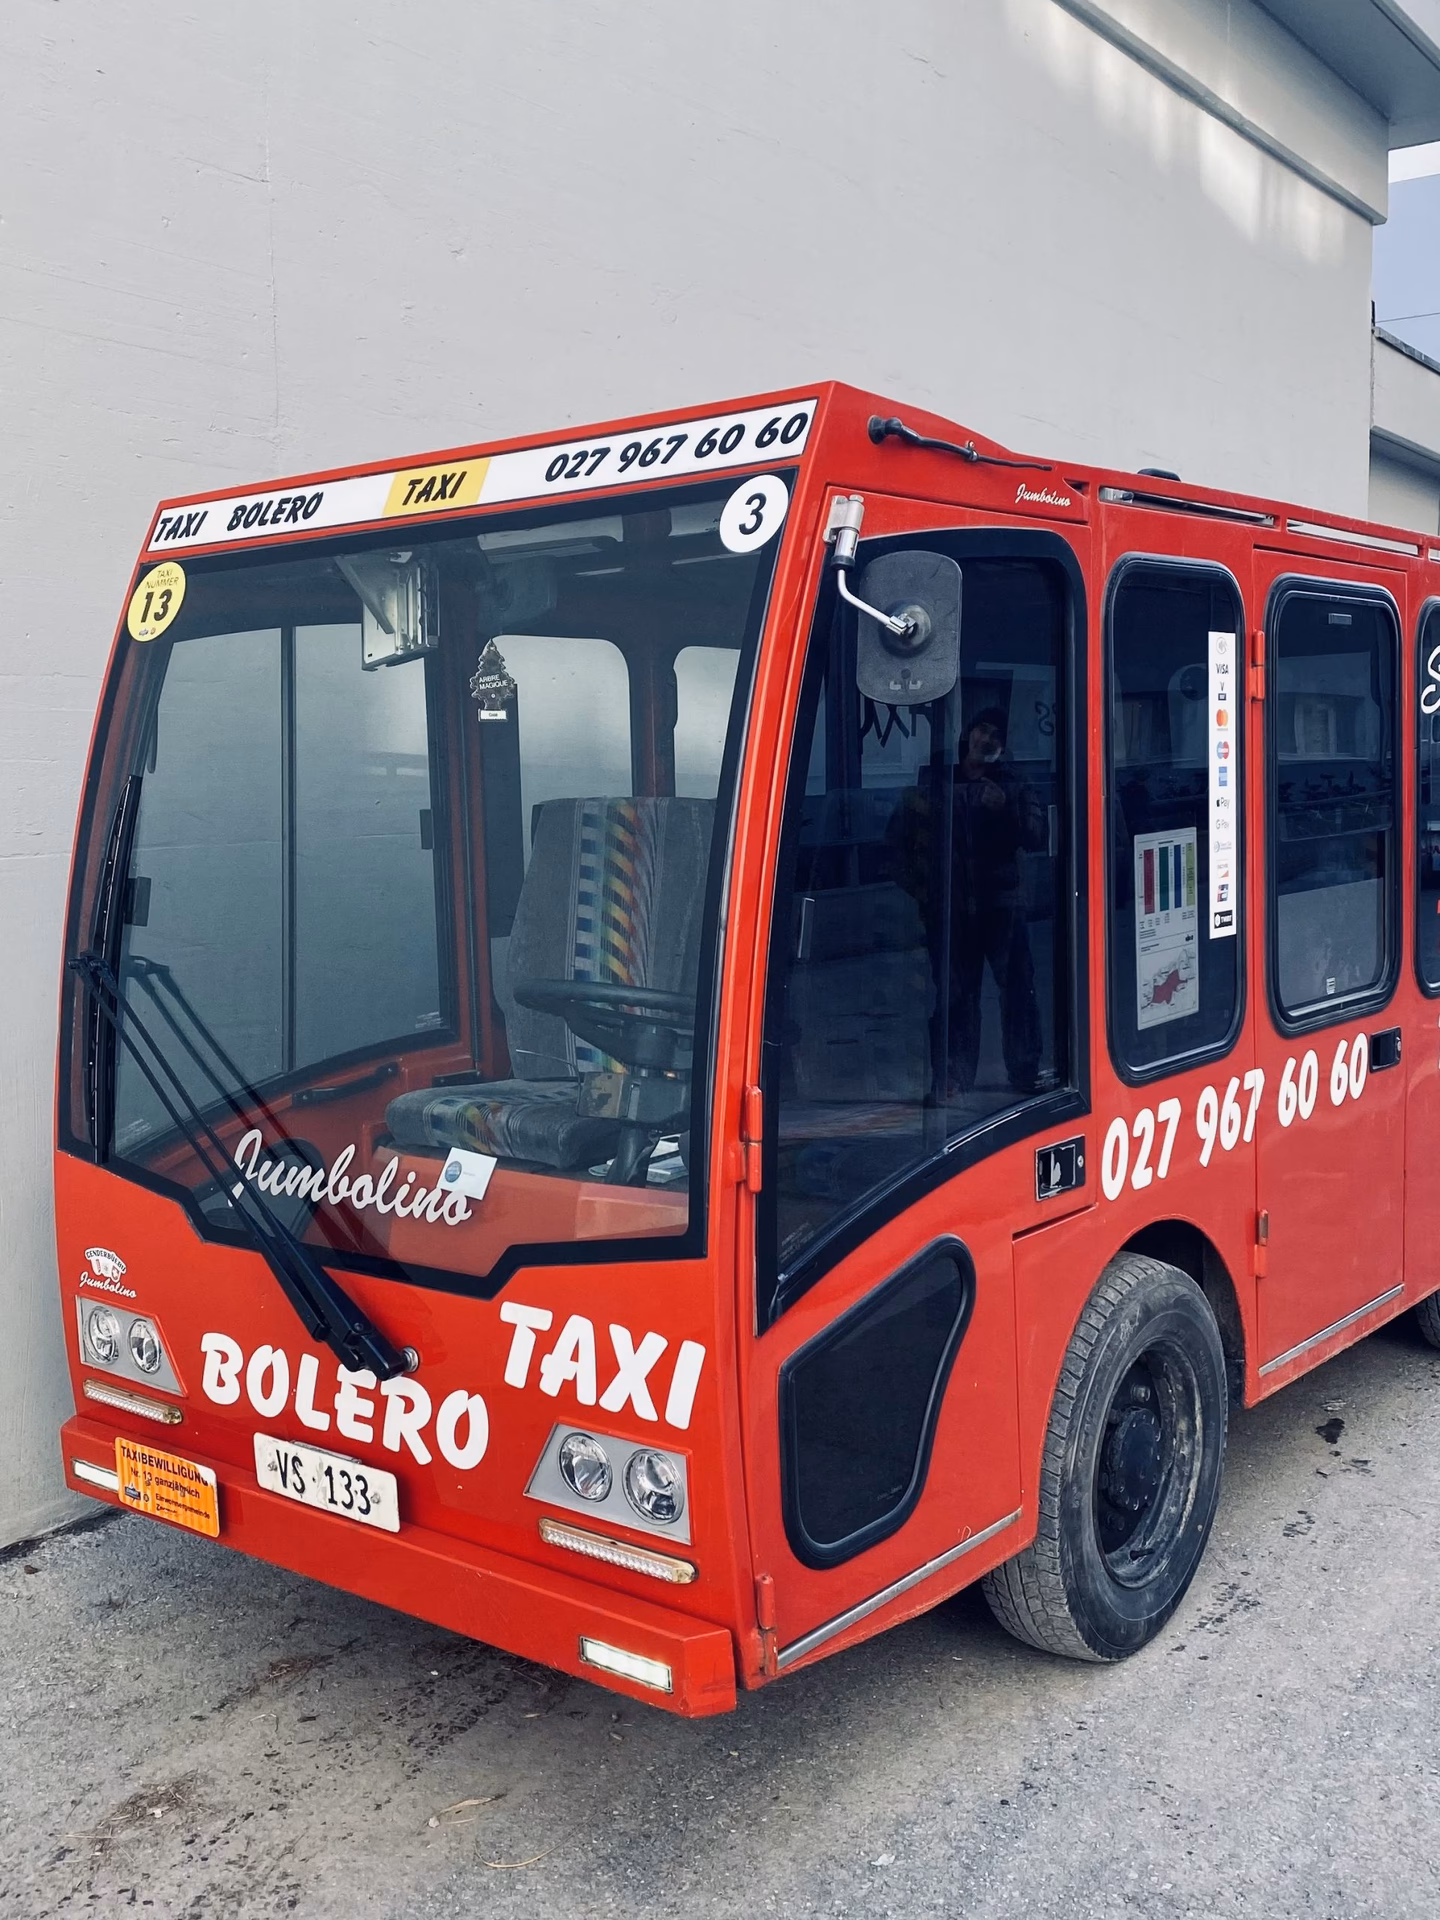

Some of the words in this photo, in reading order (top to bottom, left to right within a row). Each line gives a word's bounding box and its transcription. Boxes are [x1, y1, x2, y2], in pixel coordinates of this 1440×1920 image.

[154, 511, 208, 543] TAXI
[226, 492, 324, 531] BOLERO
[402, 471, 467, 506] TAXI
[545, 448, 611, 482] 027
[617, 434, 689, 473] 967
[694, 423, 746, 459] 60
[755, 412, 808, 449] 60
[1015, 483, 1071, 506] Jumbolino
[739, 493, 767, 535] 3
[145, 577, 179, 589] NUMMER
[157, 568, 173, 578] TAXI
[141, 589, 172, 623] 13
[479, 674, 500, 683] ARBRE
[1215, 663, 1229, 674] VISA
[480, 680, 508, 690] MAGIQUE
[1101, 1097, 1181, 1201] 027
[1196, 1067, 1265, 1168] 967
[1277, 1049, 1319, 1128] 60
[1330, 1032, 1368, 1107] 60
[228, 1128, 472, 1226] Jumbolino
[79, 1271, 137, 1298] Jumbolino
[500, 1301, 706, 1430] TAXI
[201, 1332, 489, 1470] BOLERO
[143, 1470, 152, 1482] 13
[276, 1449, 305, 1494] VS
[324, 1465, 371, 1515] 133
